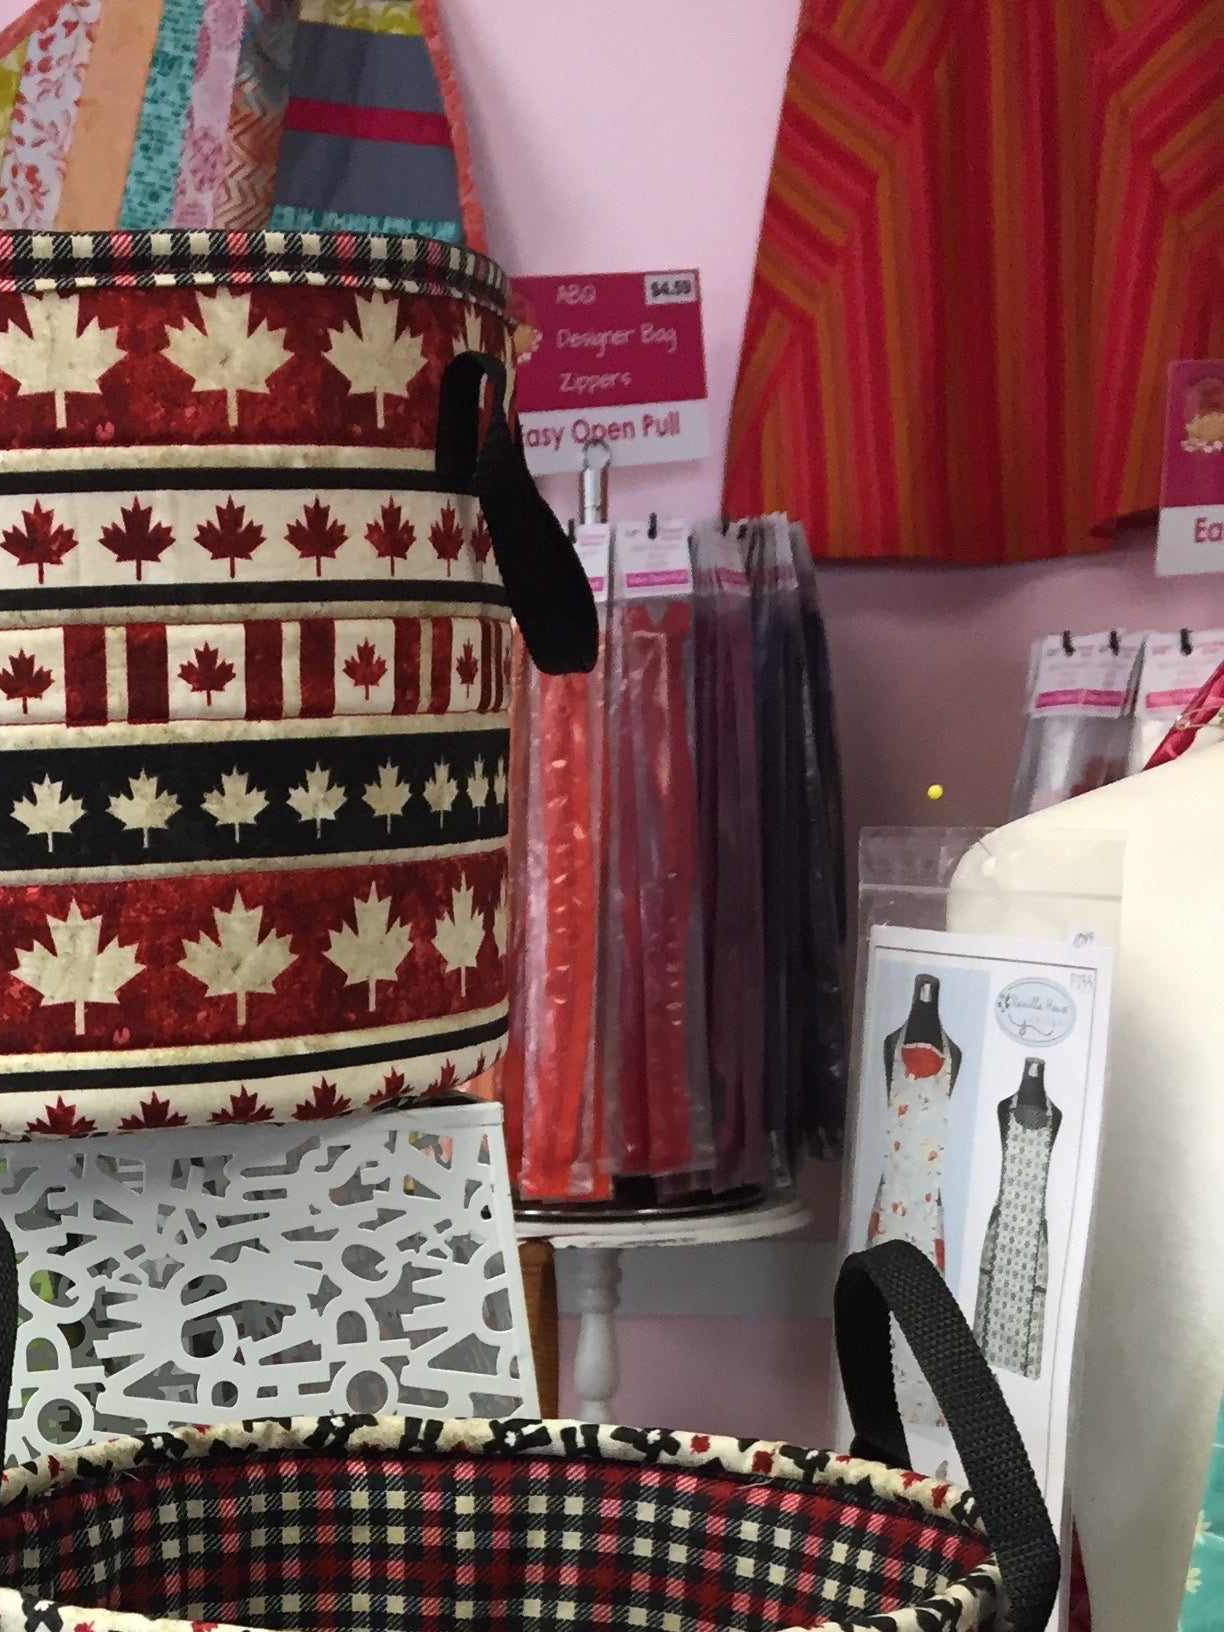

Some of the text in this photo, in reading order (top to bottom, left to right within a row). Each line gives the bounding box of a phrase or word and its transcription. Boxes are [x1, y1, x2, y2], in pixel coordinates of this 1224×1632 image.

[556, 323, 678, 358] Designer Bag
[559, 372, 633, 395] Zippers
[521, 411, 680, 450] asy Open Pull
